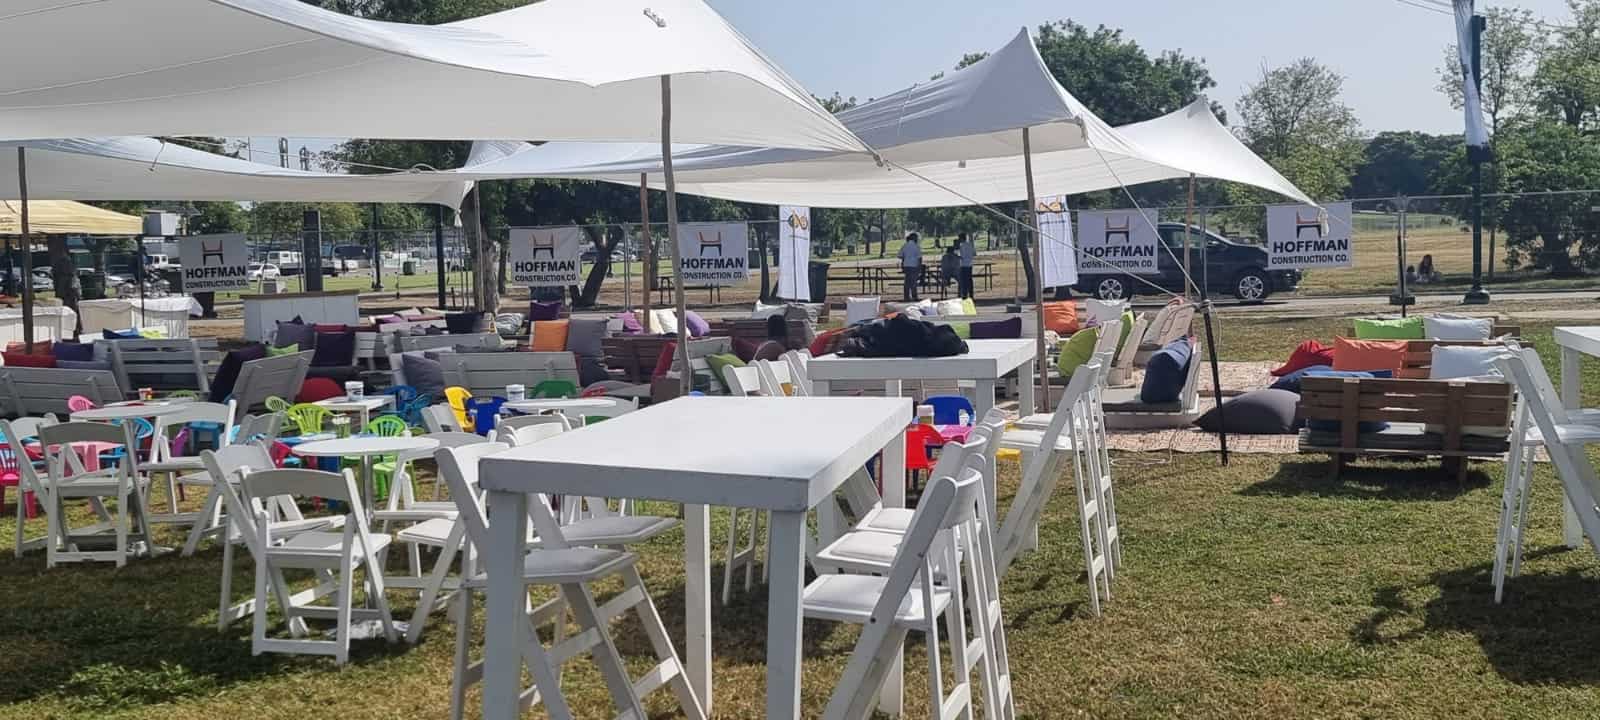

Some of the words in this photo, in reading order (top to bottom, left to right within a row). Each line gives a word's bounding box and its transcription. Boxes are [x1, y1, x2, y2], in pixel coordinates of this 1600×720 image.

[1083, 244, 1154, 258] HOFFMAN
[1273, 238, 1348, 253] HOFFMAN
[515, 260, 575, 272] HOFFMAN
[680, 257, 744, 269] HOFFMAN
[185, 265, 246, 279] HOFFMAN
